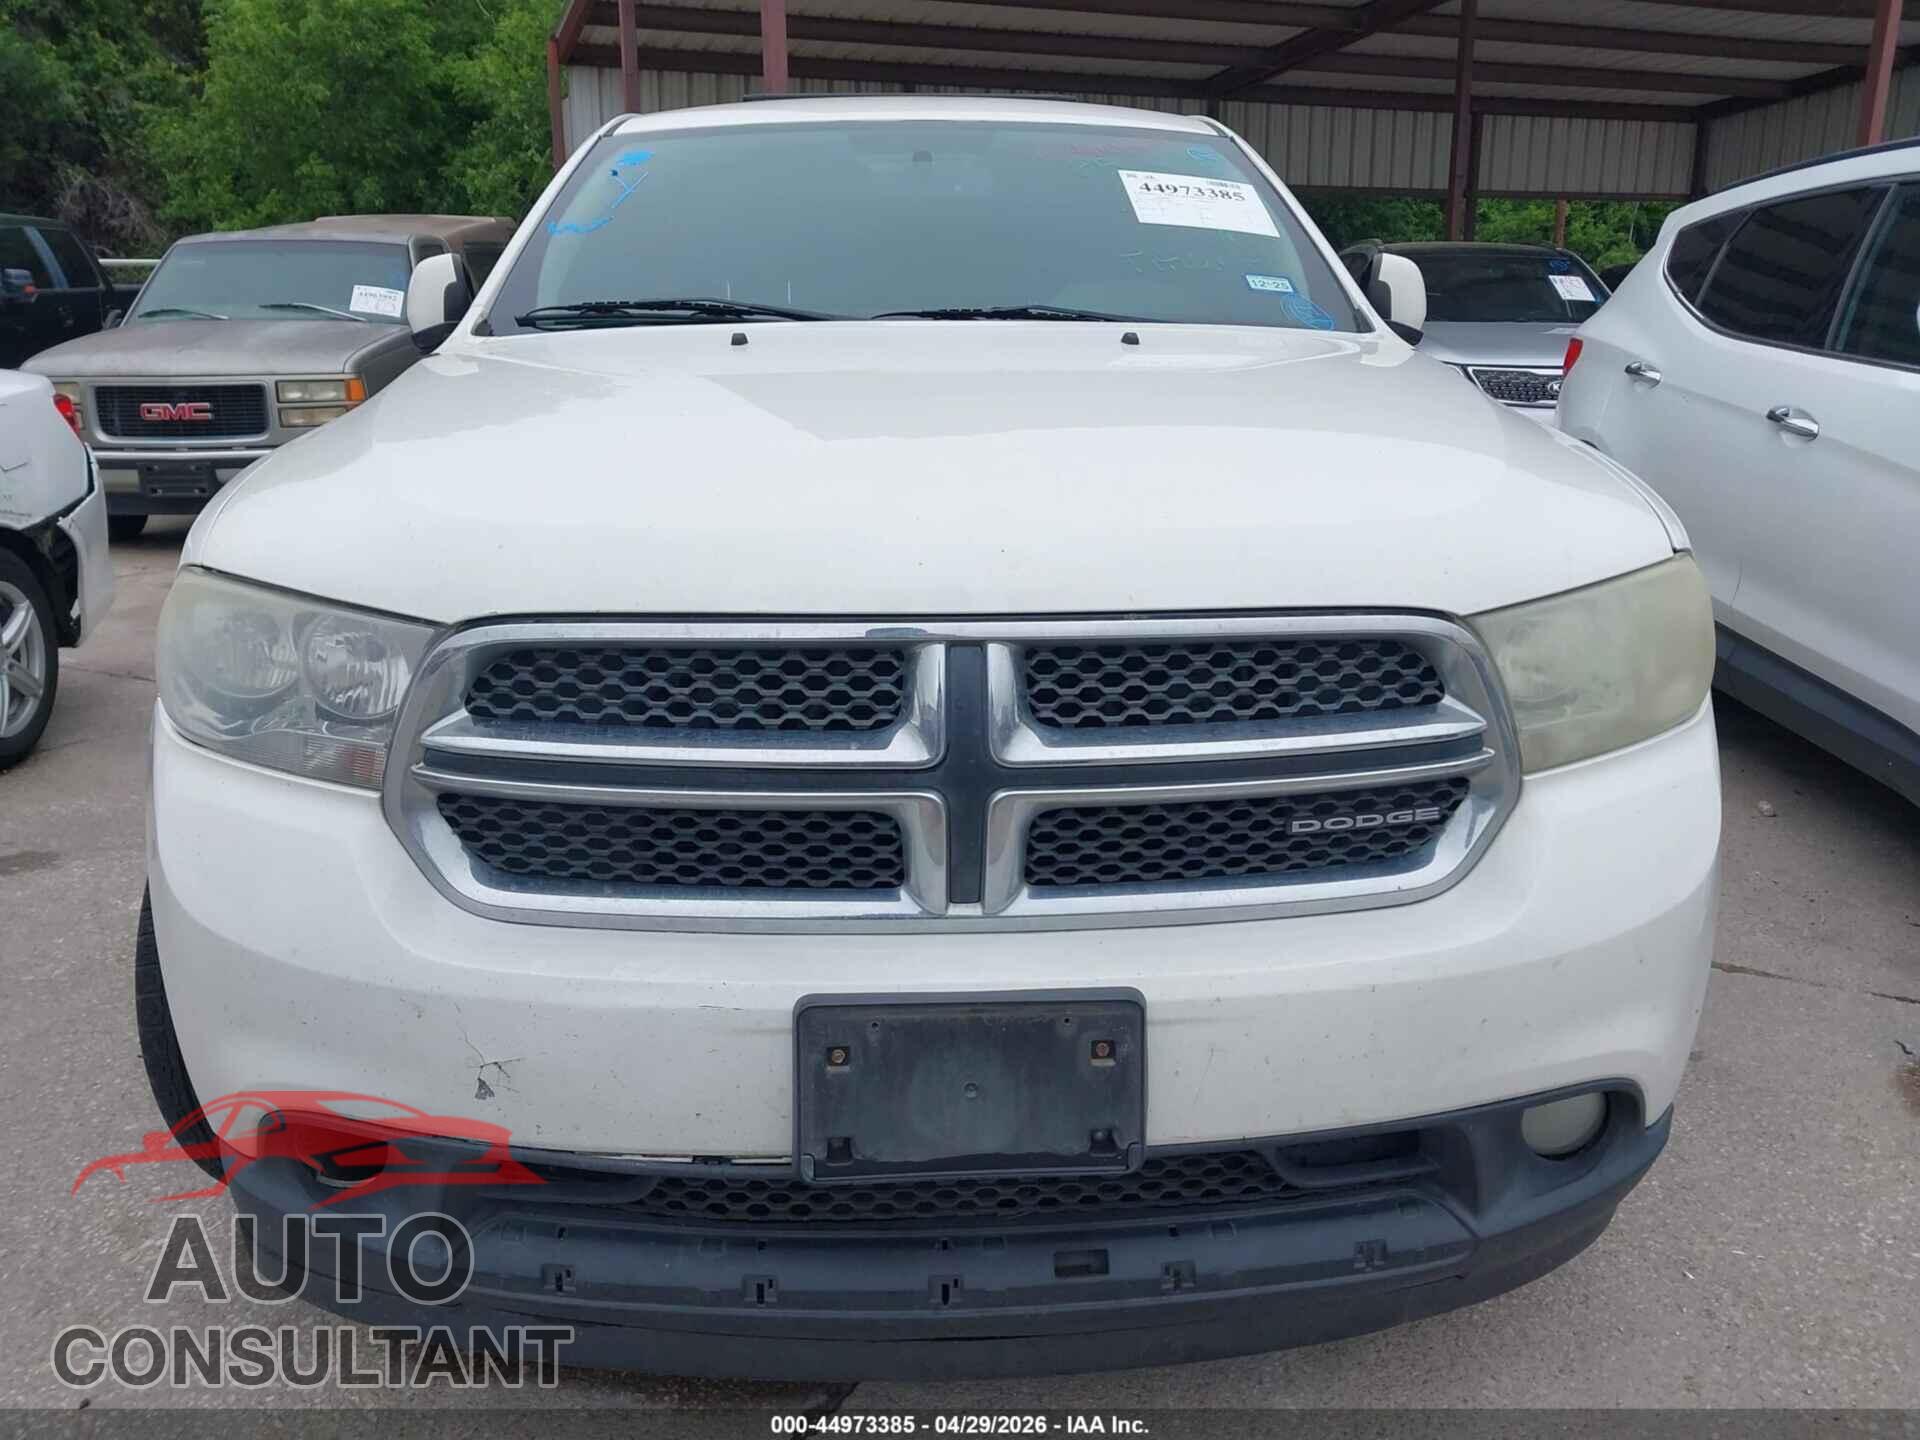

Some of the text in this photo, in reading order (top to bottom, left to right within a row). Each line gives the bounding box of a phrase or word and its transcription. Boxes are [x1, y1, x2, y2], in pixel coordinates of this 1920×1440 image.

[1139, 182, 1246, 201] 44973385
[139, 402, 212, 421] GMC
[1291, 806, 1441, 833] DODGE
